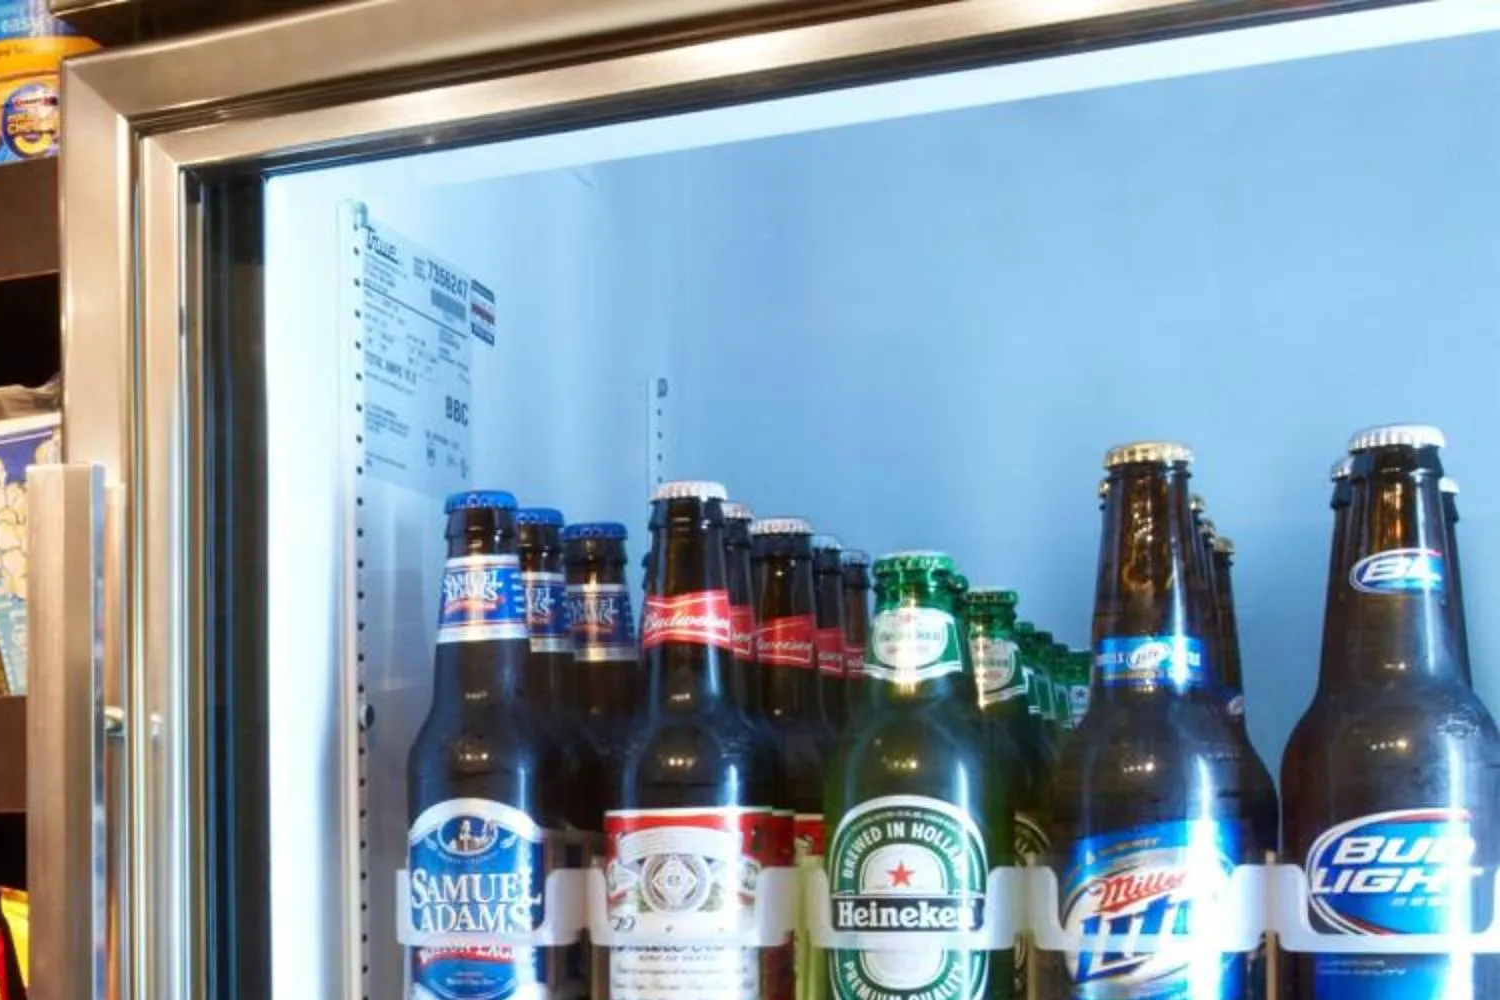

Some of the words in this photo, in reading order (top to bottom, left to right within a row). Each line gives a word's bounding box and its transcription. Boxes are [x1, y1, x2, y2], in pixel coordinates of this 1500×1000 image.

[841, 825, 883, 880] BREWED
[886, 820, 906, 839] IN
[1331, 835, 1476, 866] BUD
[411, 867, 542, 909] SAMUEL
[1311, 866, 1485, 894] LIGHT
[419, 903, 533, 934] ADAMS
[837, 899, 977, 930] Heineken
